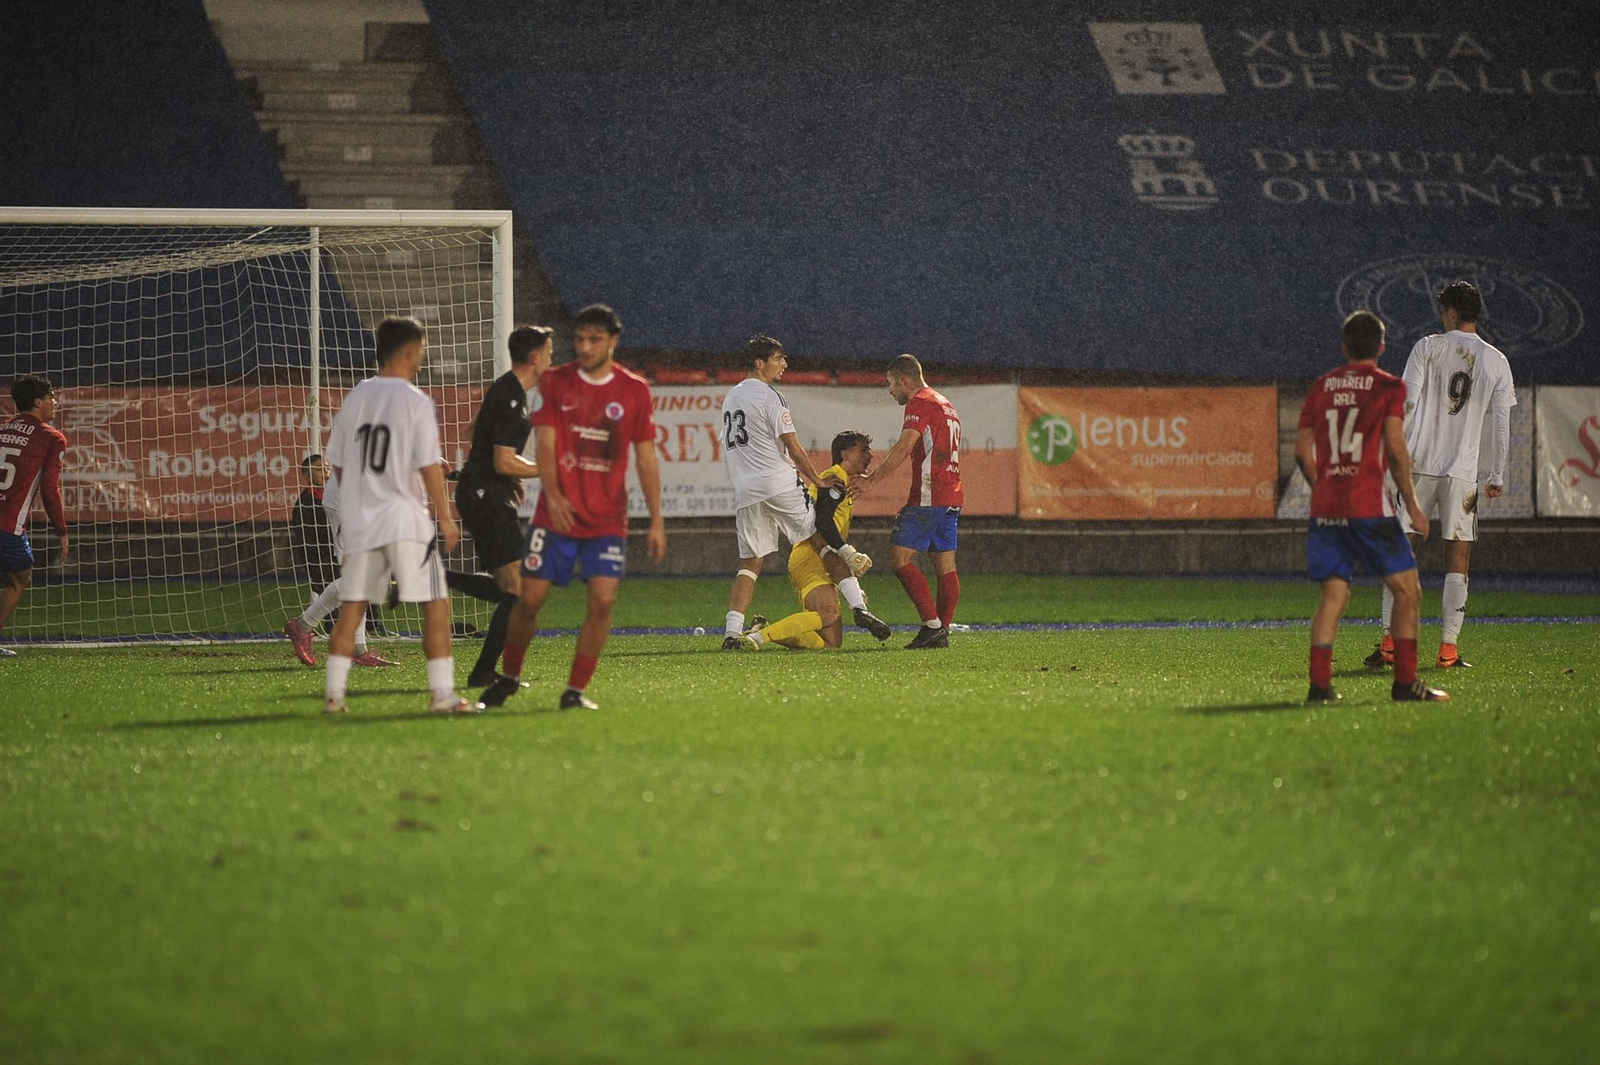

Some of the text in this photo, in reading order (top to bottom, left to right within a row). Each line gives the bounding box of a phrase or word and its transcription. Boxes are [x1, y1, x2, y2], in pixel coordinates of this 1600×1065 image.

[1237, 29, 1493, 61] XUNTA
[1246, 63, 1339, 90] DE
[1262, 177, 1591, 207] OURENSE
[1447, 370, 1473, 416] 9
[655, 422, 721, 463] REY
[723, 409, 749, 451] 23
[1325, 407, 1364, 465] 14
[149, 449, 289, 477] Roberto
[355, 423, 391, 475] 10
[1131, 451, 1254, 467] supermercados
[530, 528, 546, 553] 6
